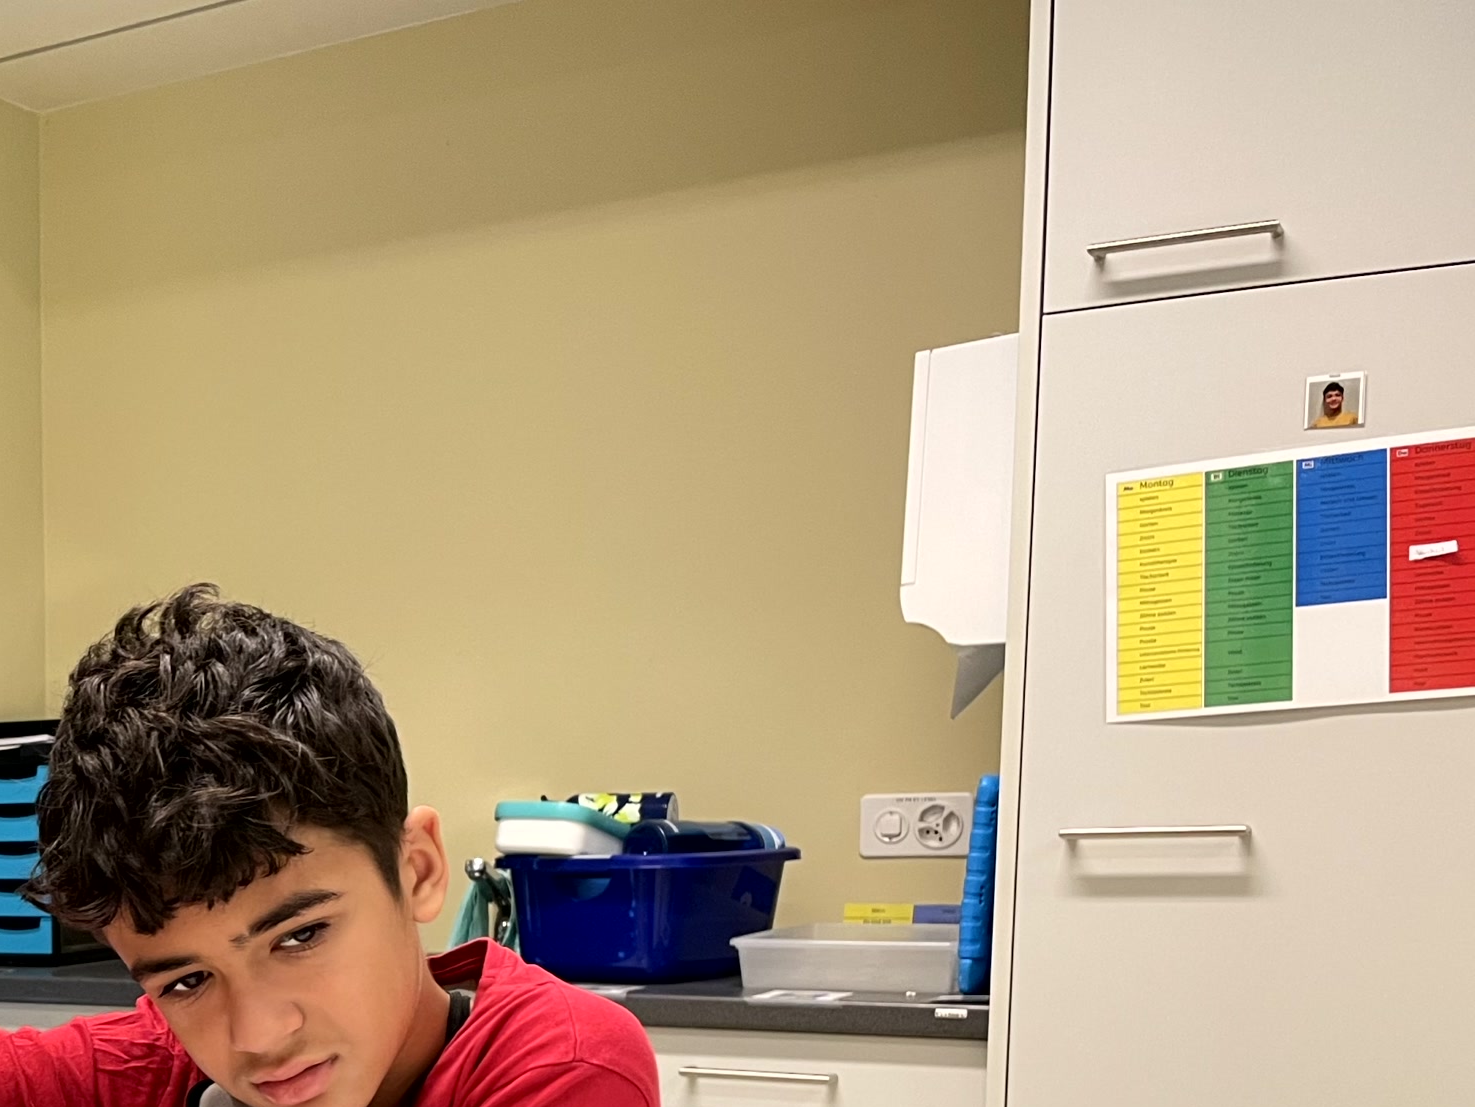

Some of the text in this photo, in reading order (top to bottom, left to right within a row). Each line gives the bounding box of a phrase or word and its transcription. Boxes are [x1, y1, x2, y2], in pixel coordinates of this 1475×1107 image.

[1415, 441, 1472, 454] Donnerstag
[1228, 466, 1268, 478] Dienstag
[1140, 478, 1174, 490] Montag
